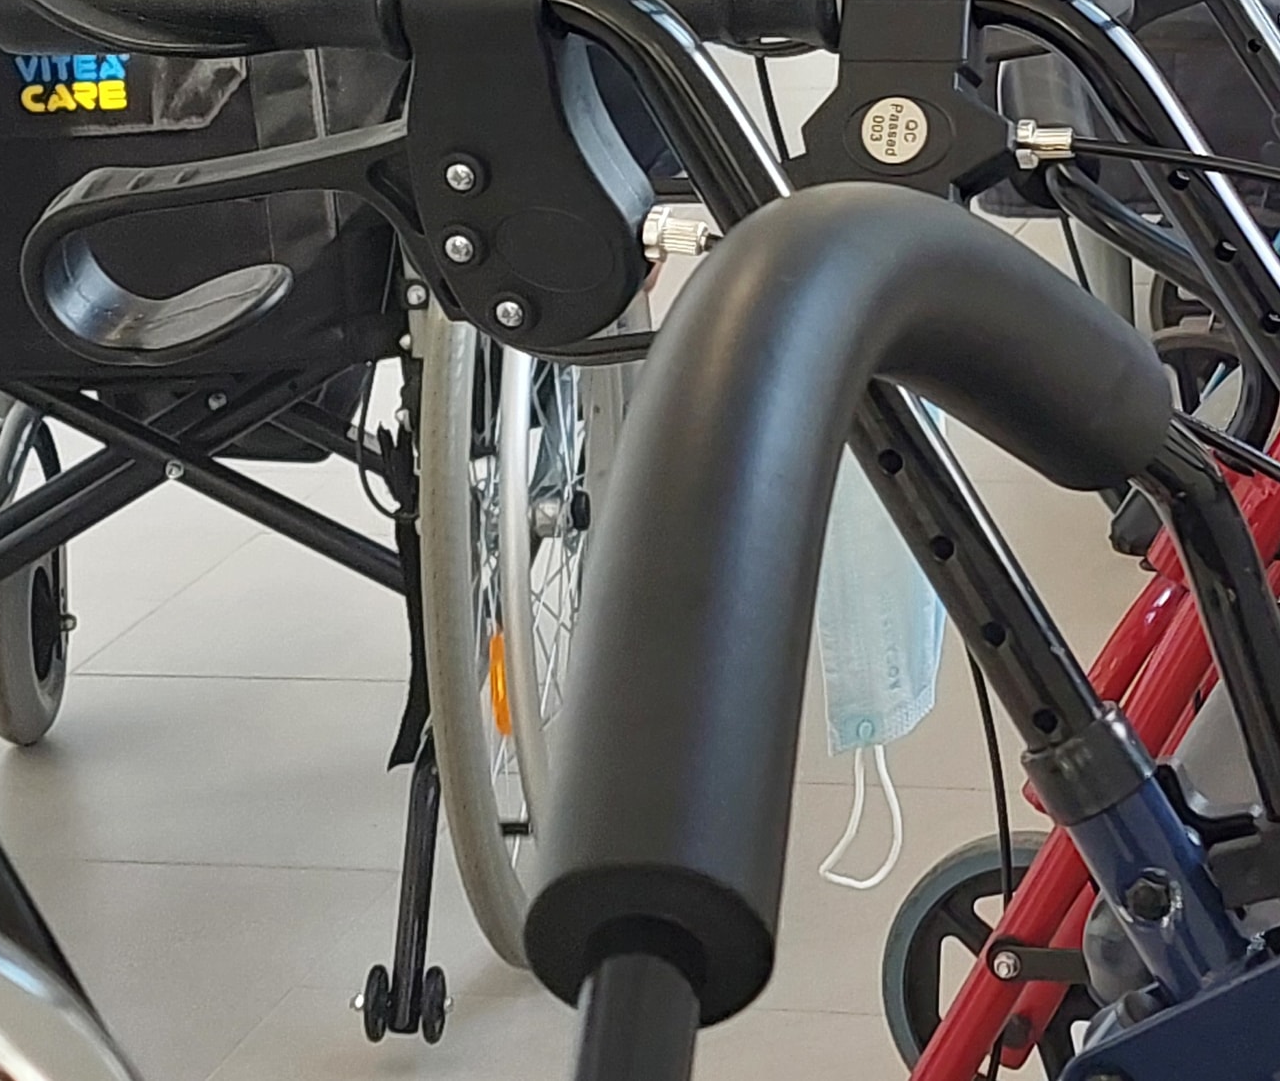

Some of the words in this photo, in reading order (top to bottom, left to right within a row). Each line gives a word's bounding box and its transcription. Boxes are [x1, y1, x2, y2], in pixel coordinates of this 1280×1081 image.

[15, 54, 126, 82] VITEA
[20, 80, 128, 112] CARE
[869, 115, 886, 142] 003
[884, 103, 904, 157] Passed
[903, 119, 919, 144] QC
